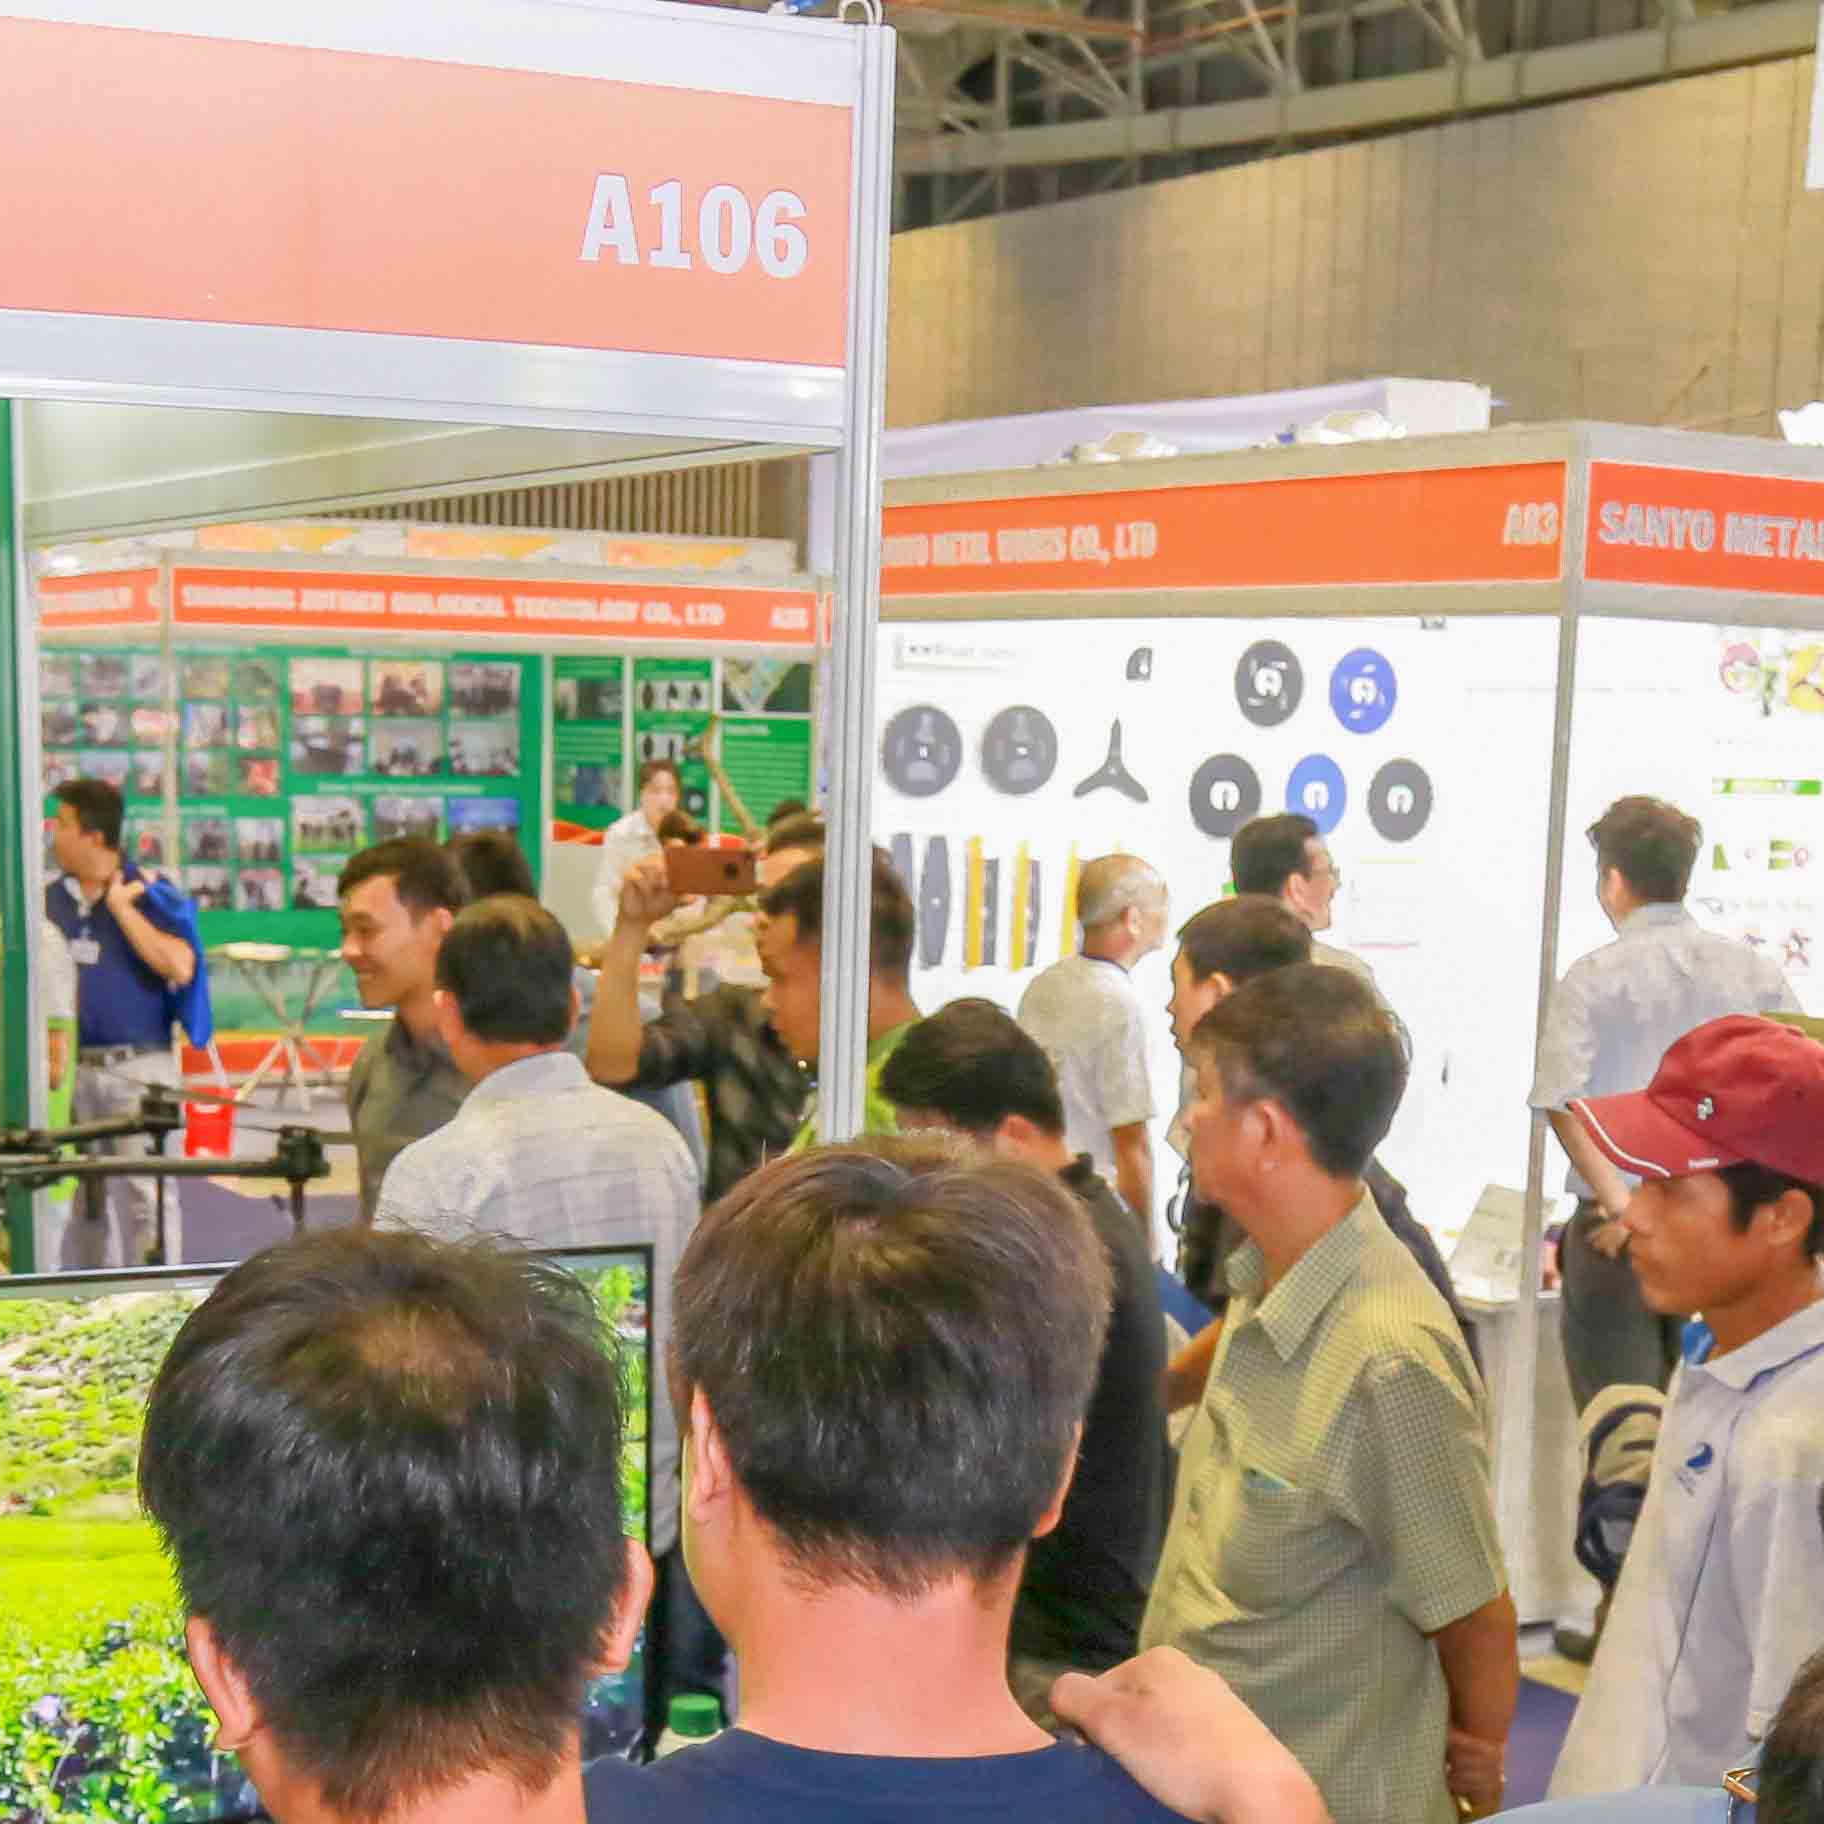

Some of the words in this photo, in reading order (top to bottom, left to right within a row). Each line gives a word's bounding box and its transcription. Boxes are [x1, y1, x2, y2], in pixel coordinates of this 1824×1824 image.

[578, 173, 808, 279] A106
[1115, 520, 1157, 559] LTD
[1598, 501, 1716, 552] SANYO
[684, 602, 726, 626] LTD
